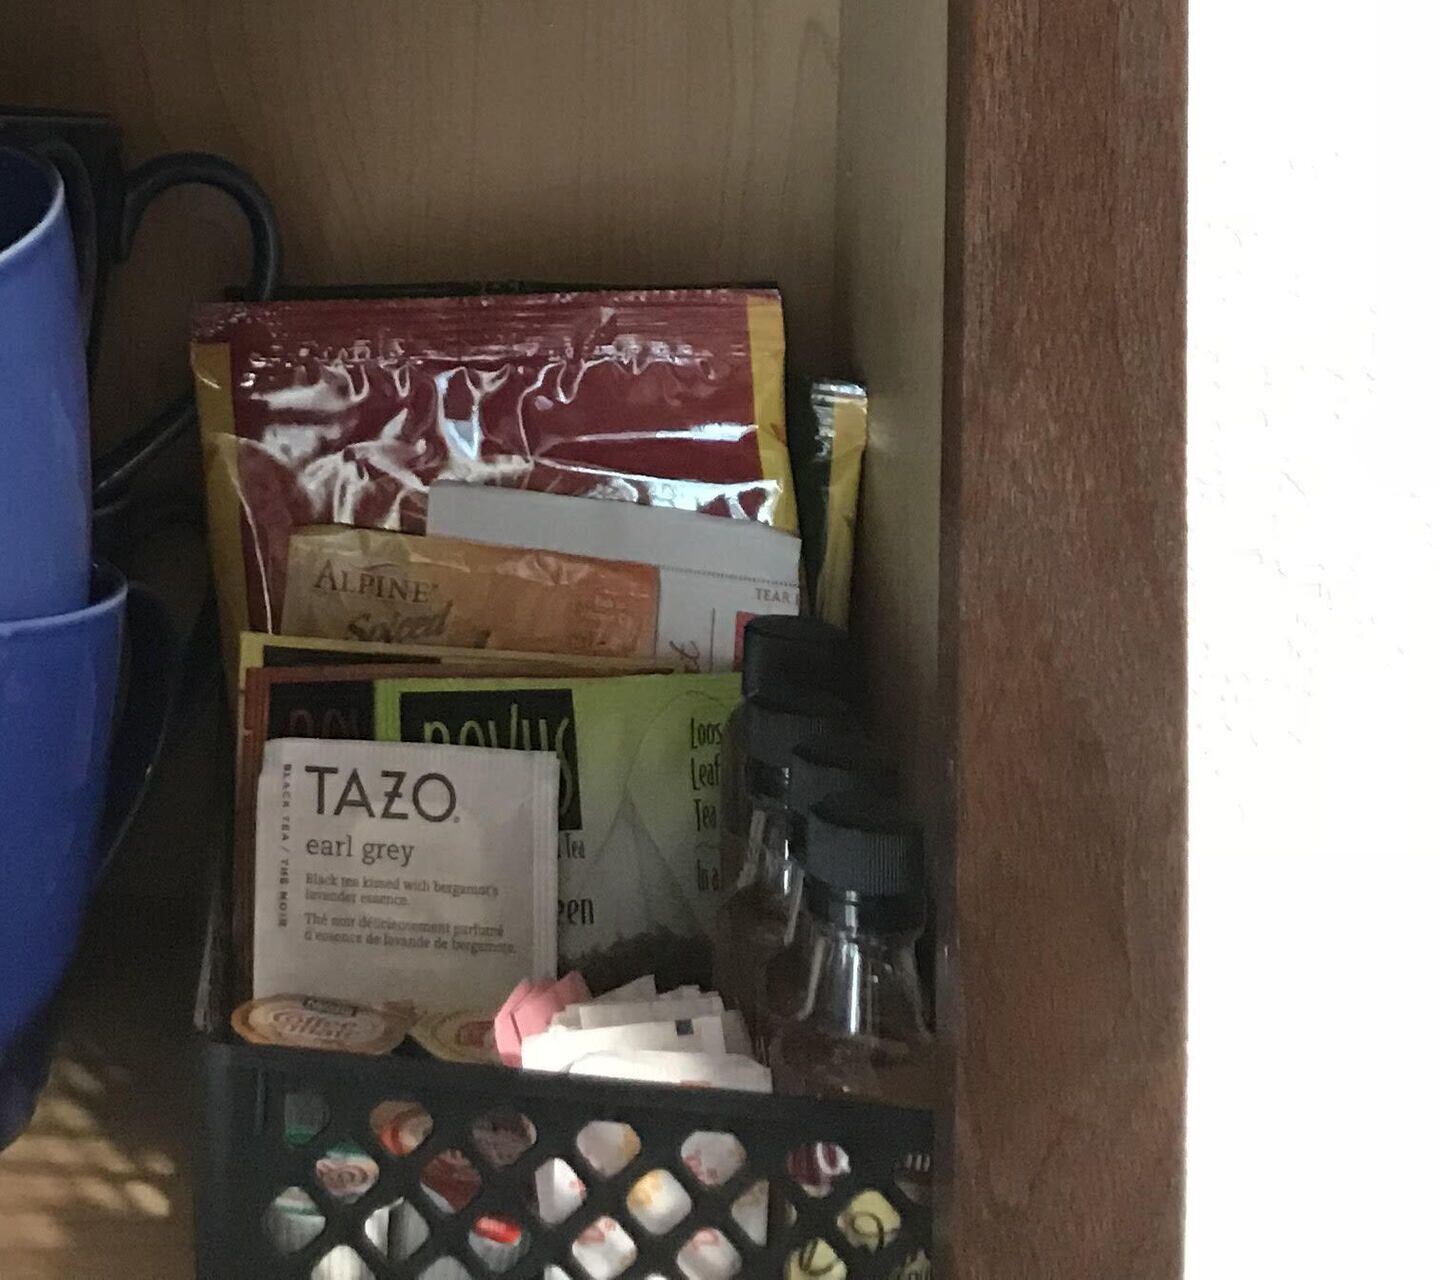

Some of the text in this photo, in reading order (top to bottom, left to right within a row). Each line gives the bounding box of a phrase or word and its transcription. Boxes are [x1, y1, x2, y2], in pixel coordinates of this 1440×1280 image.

[314, 559, 430, 604] ALPINE
[755, 588, 789, 604] TEAR
[690, 717, 722, 749] Loos
[690, 753, 721, 790] Leaf
[304, 765, 457, 823] TAZO
[694, 798, 717, 831] Tea
[306, 834, 415, 868] earl grey
[565, 832, 586, 859] Tea
